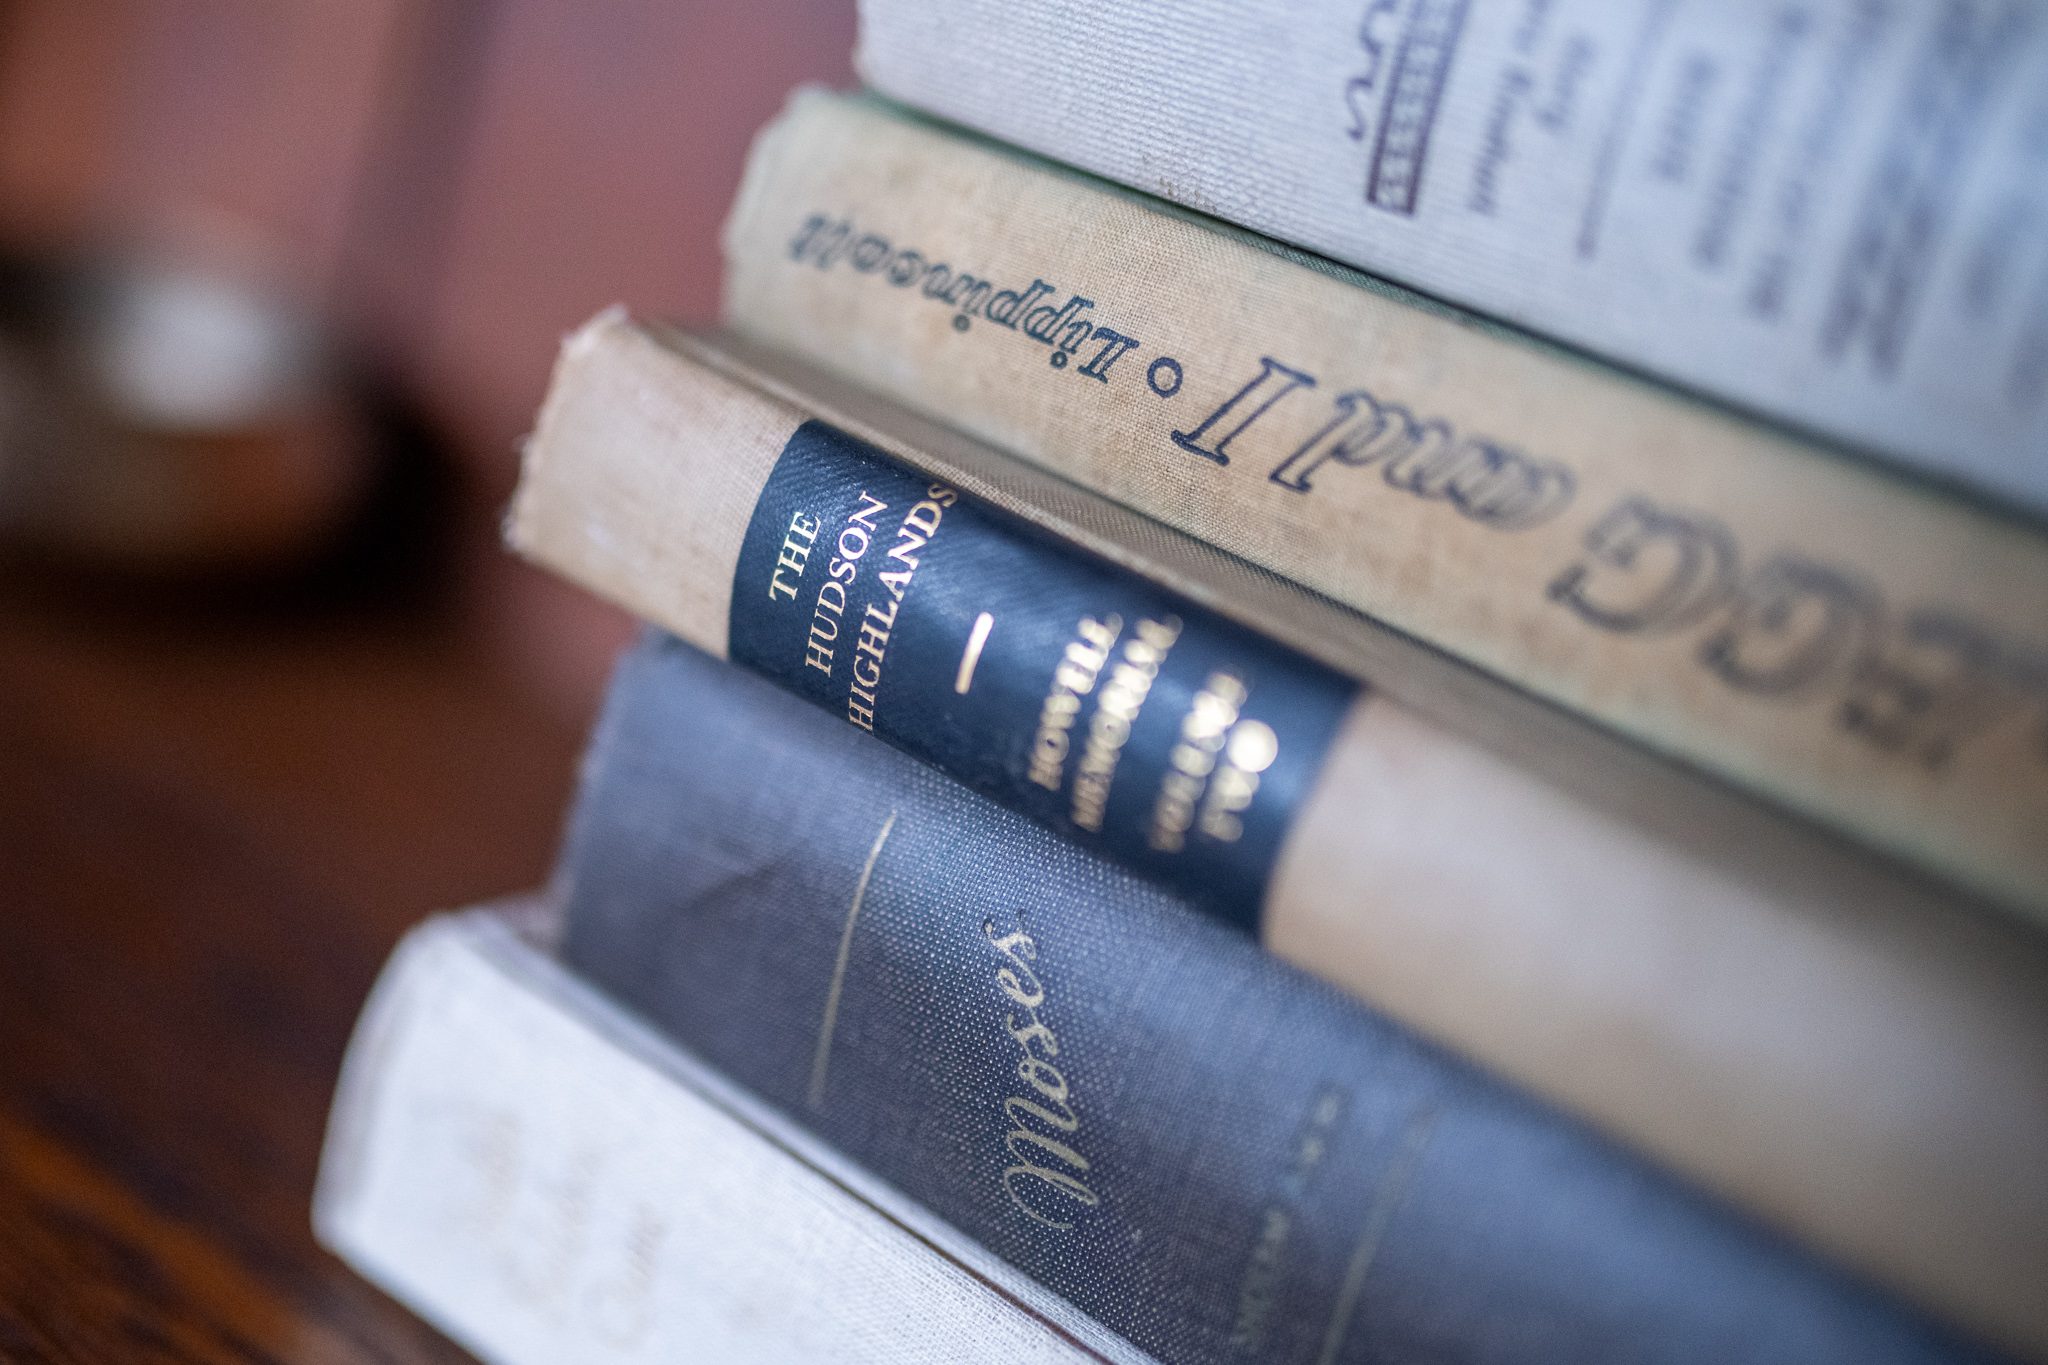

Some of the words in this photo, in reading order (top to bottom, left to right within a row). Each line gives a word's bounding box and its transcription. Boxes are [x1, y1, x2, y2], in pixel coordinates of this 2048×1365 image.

[786, 212, 1139, 384] Lippincott
[1170, 356, 1318, 467] I
[1268, 388, 1576, 533] and
[768, 511, 822, 601] THE
[805, 490, 888, 678] HUDSON
[849, 482, 958, 732] HIGHLANDS
[981, 910, 1102, 1230] Moses
